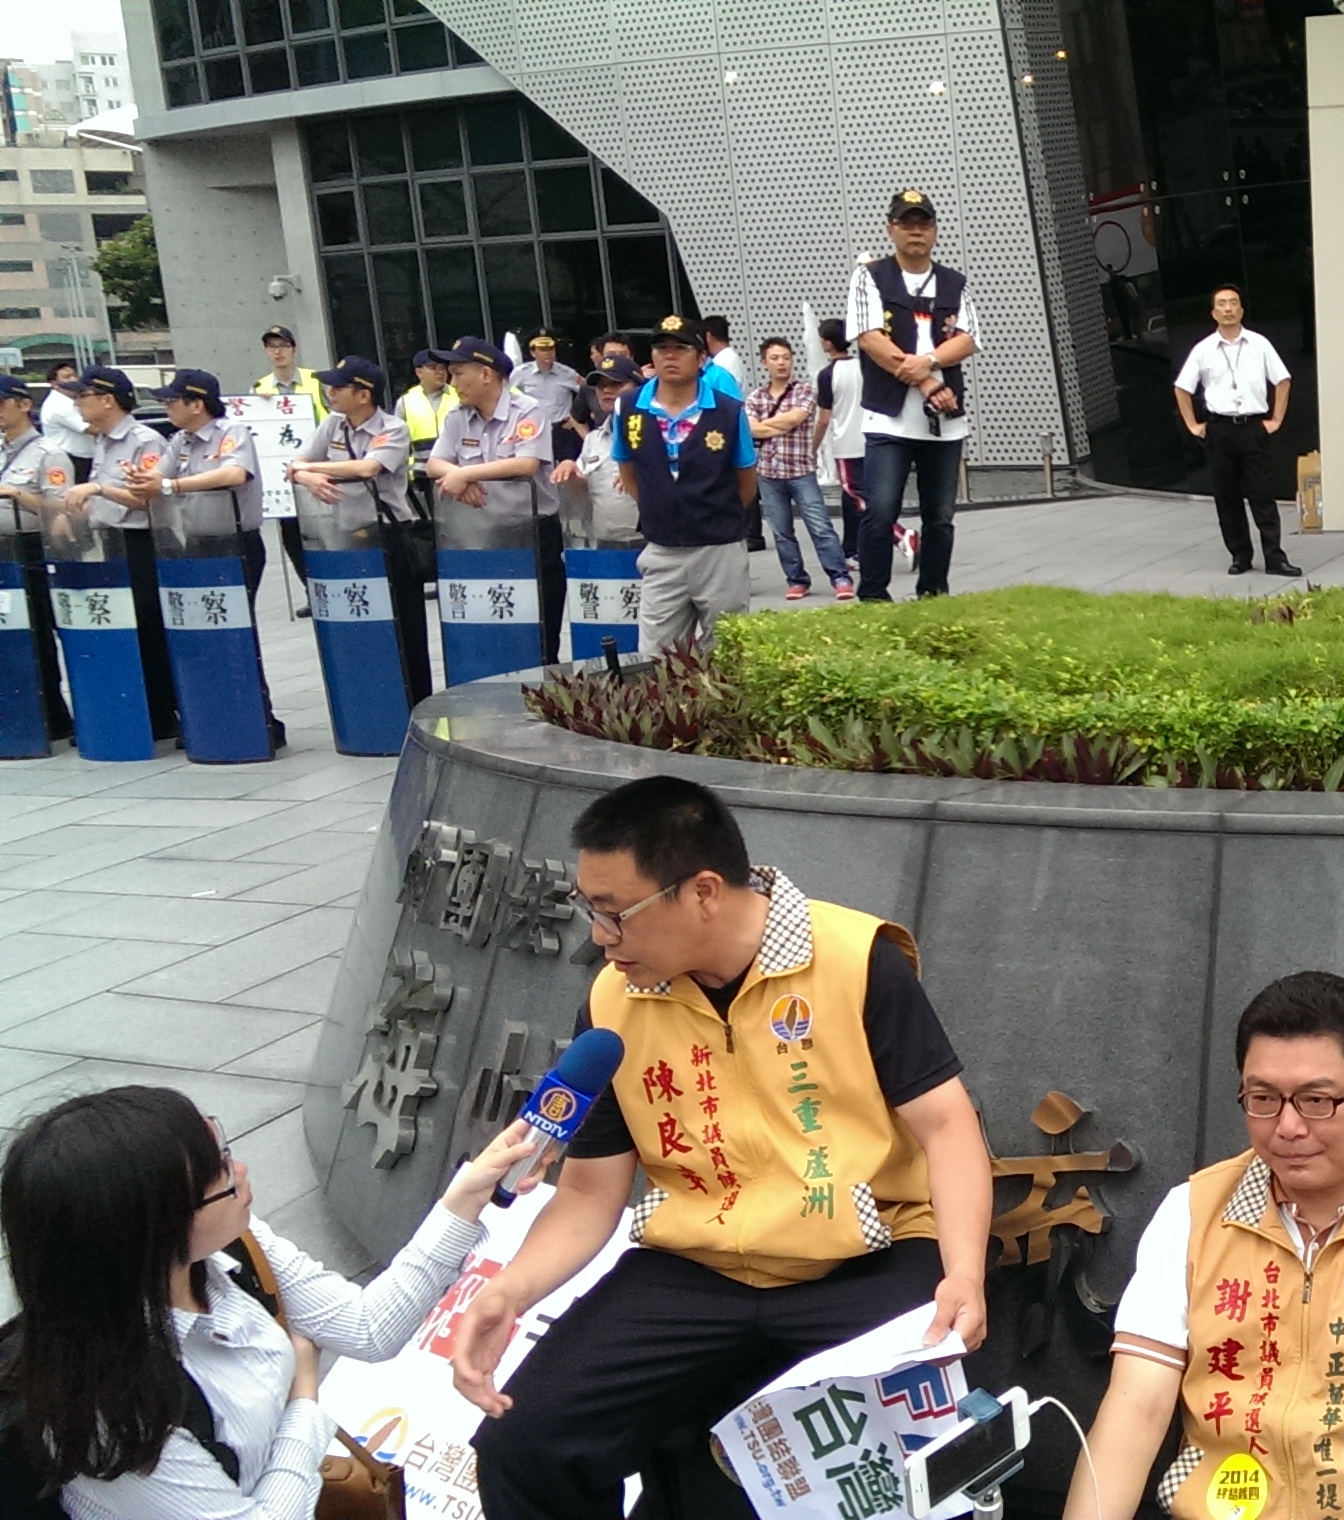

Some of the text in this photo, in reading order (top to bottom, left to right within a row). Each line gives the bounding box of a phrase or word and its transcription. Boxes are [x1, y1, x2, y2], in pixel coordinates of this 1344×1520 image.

[167, 590, 228, 626] 警察
[313, 582, 370, 618] 警察
[449, 583, 515, 619] 警察
[524, 1110, 568, 1138] NTDTV
[1203, 1278, 1252, 1437] 謝建平
[1245, 1260, 1281, 1456] 台北市議員候選人
[1219, 1470, 1259, 1485] 2014
